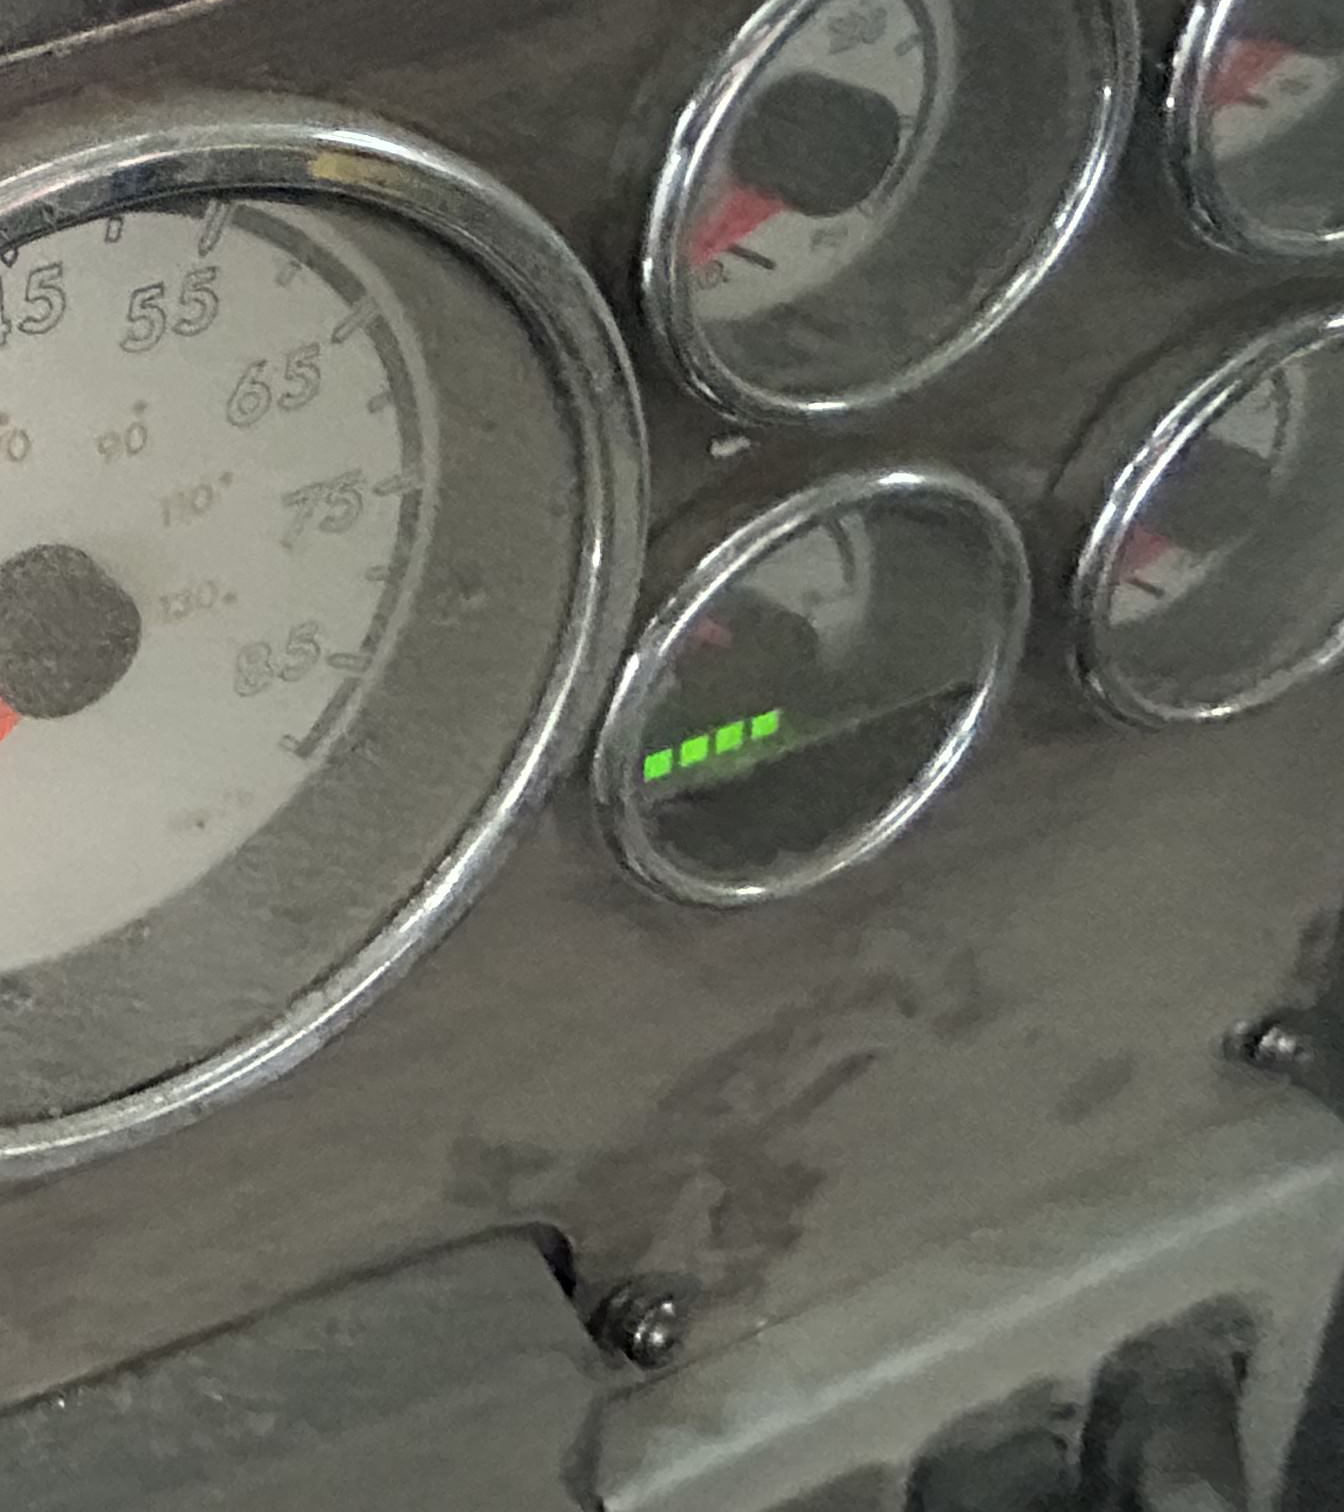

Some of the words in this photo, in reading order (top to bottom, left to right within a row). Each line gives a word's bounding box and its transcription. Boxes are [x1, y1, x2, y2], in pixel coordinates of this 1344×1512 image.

[119, 266, 220, 353] 55
[225, 342, 322, 428] 65
[280, 469, 365, 550] 75
